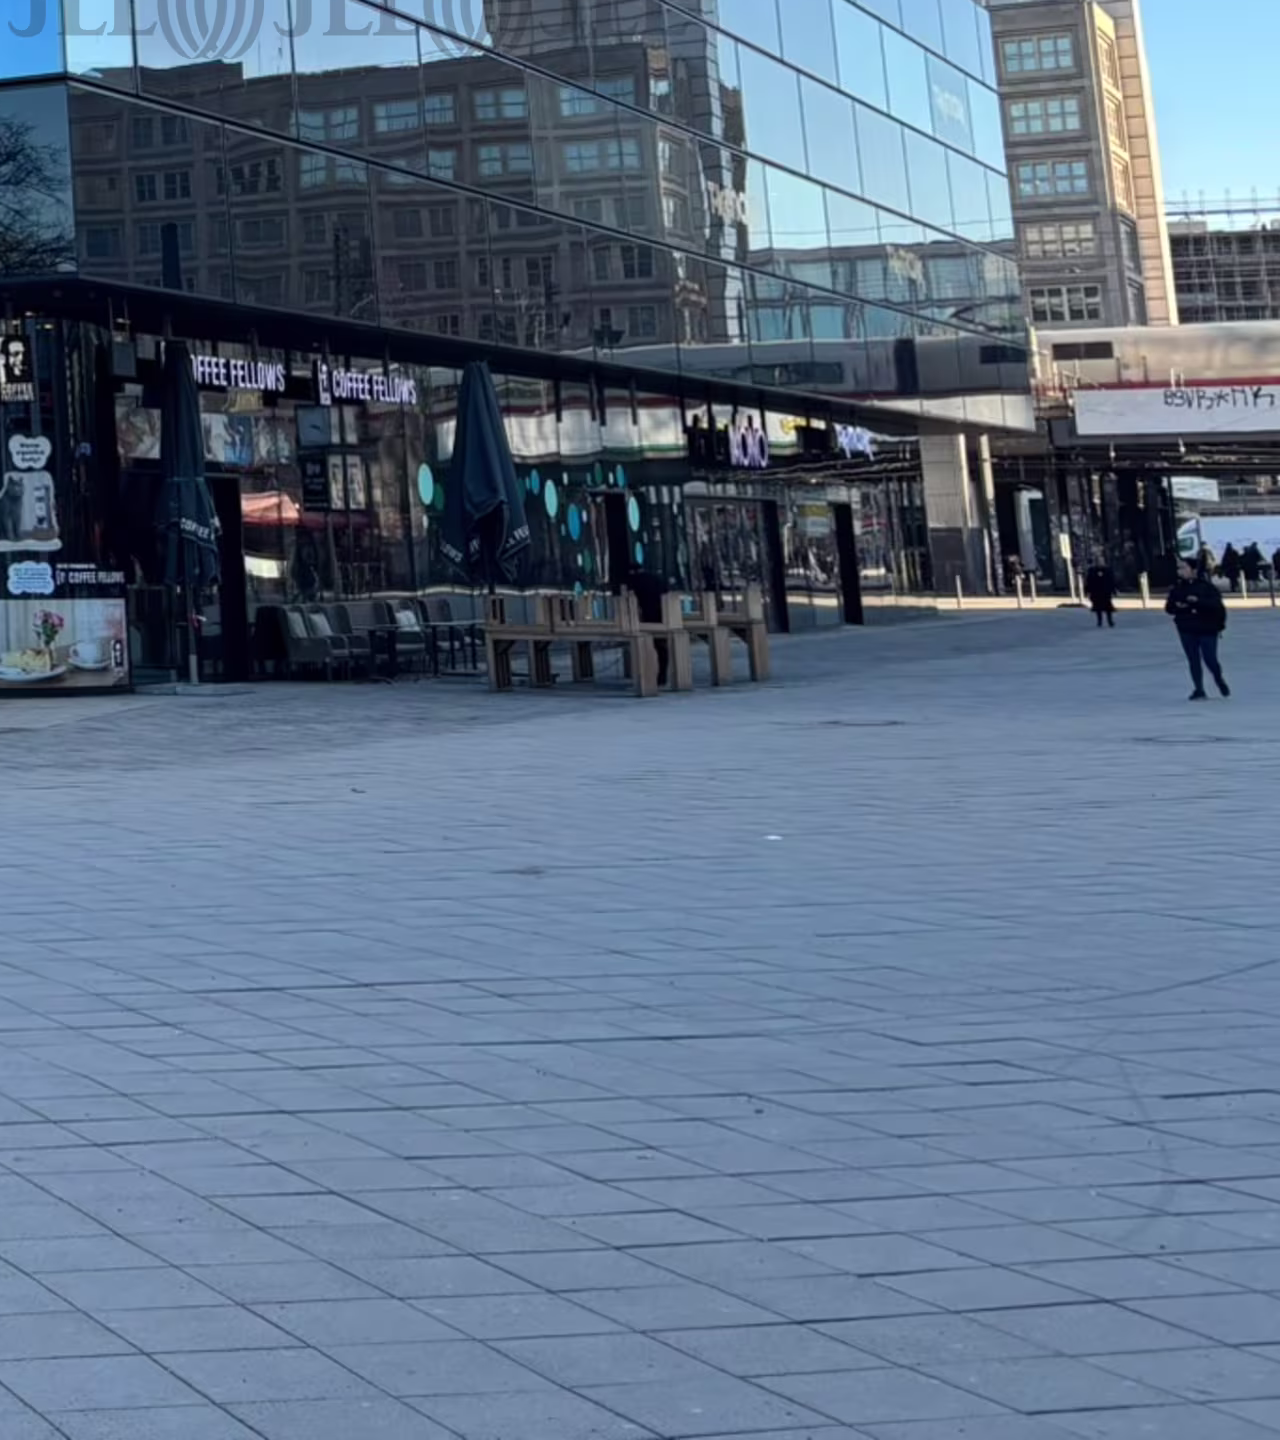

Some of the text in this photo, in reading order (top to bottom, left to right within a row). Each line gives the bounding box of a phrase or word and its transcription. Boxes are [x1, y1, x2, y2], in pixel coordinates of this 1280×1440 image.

[229, 357, 286, 393] FELLOWS
[331, 367, 417, 405] COFFEE FELLOWS
[68, 570, 97, 585] COFFEE
